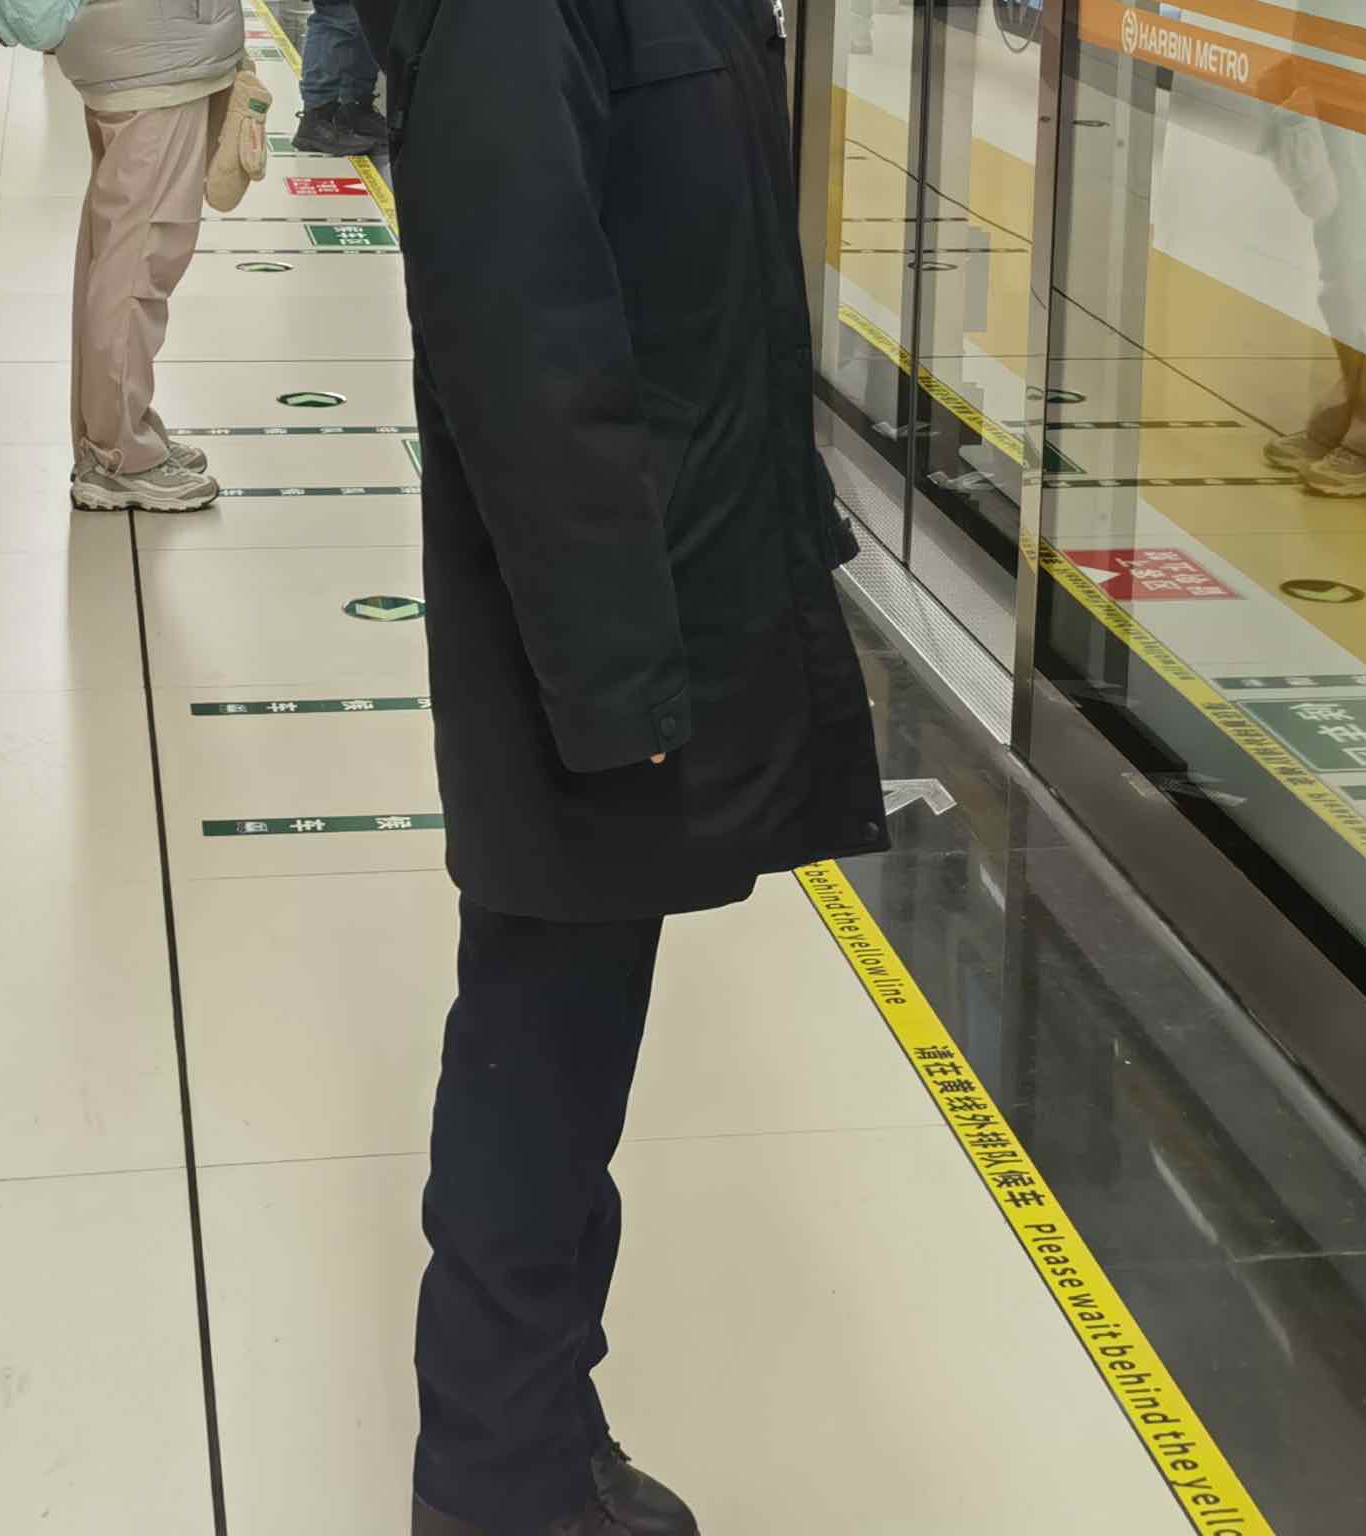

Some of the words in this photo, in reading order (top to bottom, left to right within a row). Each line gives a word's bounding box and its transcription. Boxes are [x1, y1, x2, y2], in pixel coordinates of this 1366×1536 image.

[1139, 22, 1192, 64] HARBIN
[1195, 39, 1249, 84] METRO
[804, 870, 846, 916] behind
[833, 913, 860, 934] the
[839, 932, 890, 978] yellow
[876, 976, 908, 1006] line
[914, 1045, 1046, 1208] 请在黄线外排队候车
[1024, 1222, 1085, 1289] Please
[1068, 1291, 1123, 1341] wait
[1099, 1344, 1182, 1425] behind
[1152, 1430, 1200, 1472] the
